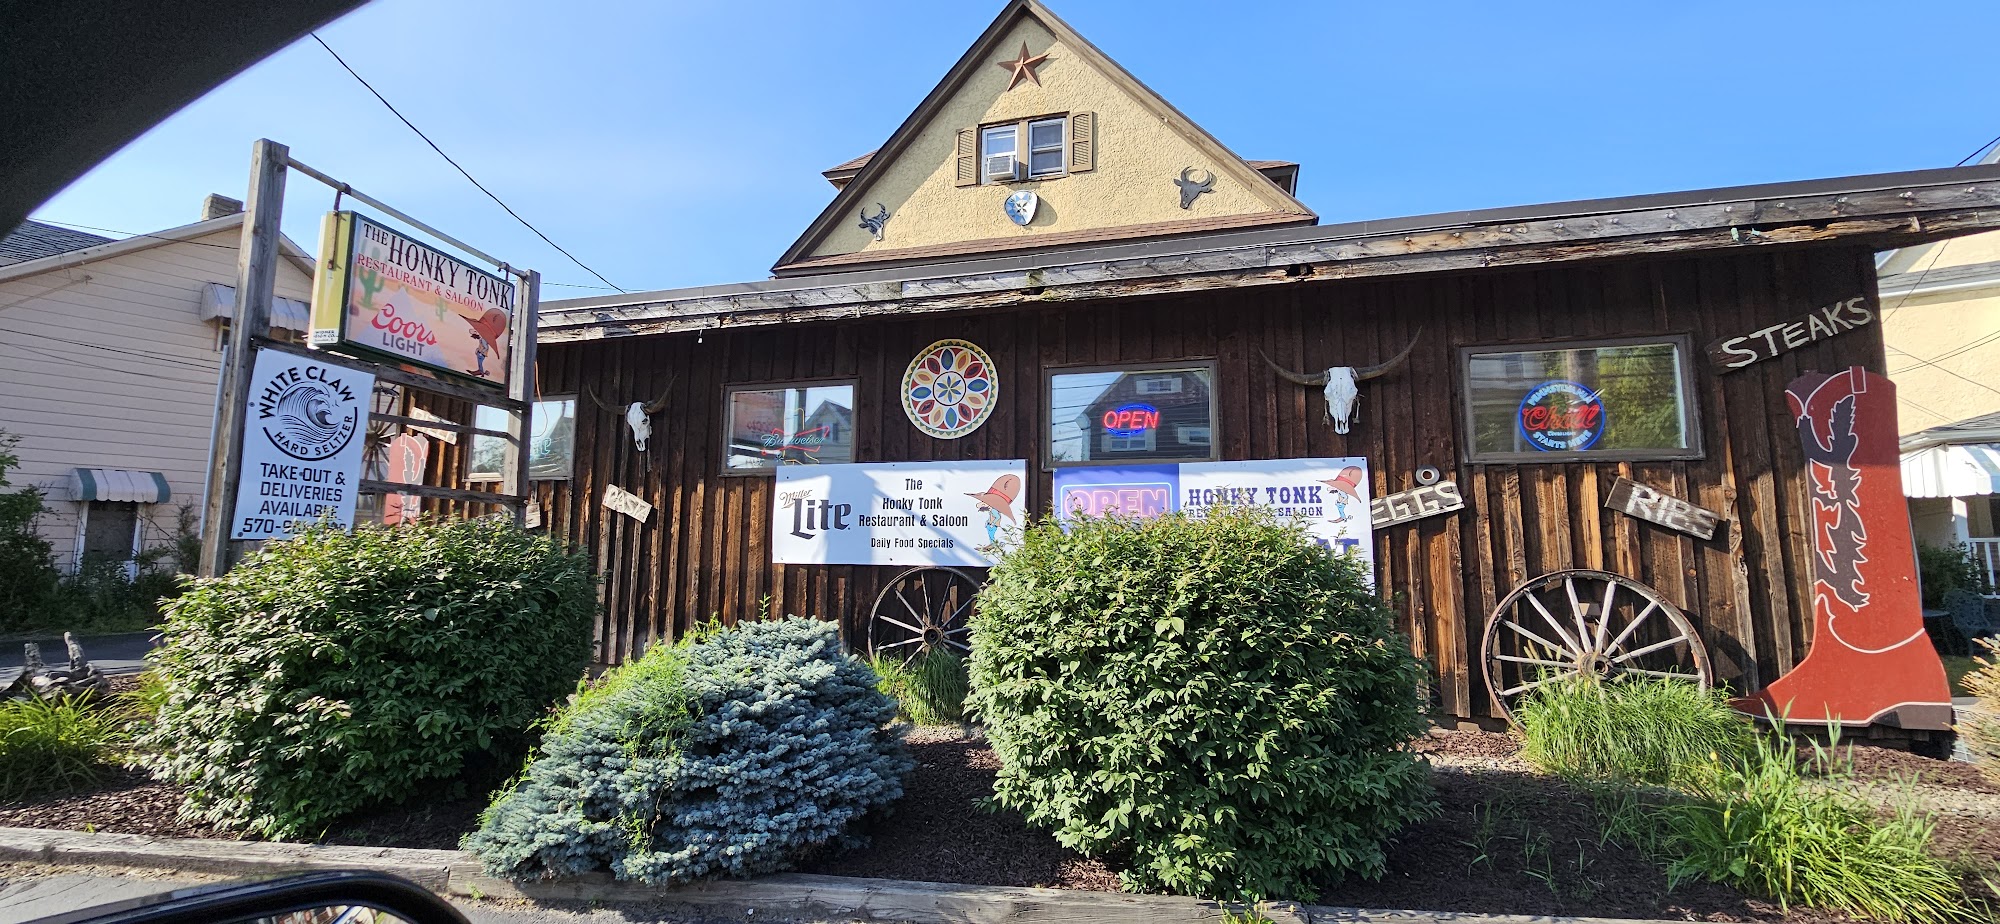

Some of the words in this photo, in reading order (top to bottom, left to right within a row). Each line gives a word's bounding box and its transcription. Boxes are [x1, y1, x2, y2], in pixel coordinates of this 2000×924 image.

[363, 223, 389, 246] THE
[388, 234, 460, 288] HONKY
[465, 269, 510, 311] TONK
[357, 252, 432, 292] RESTAURANT
[434, 285, 442, 297] &
[444, 289, 484, 311] SALOON
[371, 303, 437, 345] Coors
[1721, 296, 1872, 368] STEAKS
[382, 332, 425, 356] LIGHT
[259, 367, 301, 419] WHITE
[305, 366, 355, 402] CLAW
[1103, 409, 1160, 430] OPEN
[1522, 404, 1600, 430] Chill
[274, 431, 309, 455] HARD
[314, 415, 353, 456] SELTZER
[761, 433, 825, 448] Buweiser
[1532, 431, 1567, 449] STARTS
[260, 462, 299, 481] TAKE
[302, 467, 332, 484] OUT
[335, 471, 346, 486] &
[905, 478, 923, 491] The
[259, 481, 343, 502] DELIVERIES
[779, 489, 813, 510] Miller
[1266, 485, 1323, 504] TONK
[882, 497, 914, 511] Honky
[918, 497, 943, 510] Tonk
[1064, 489, 1167, 519] OPEN
[789, 498, 852, 541] Lite
[859, 514, 915, 527] Restaurant
[919, 514, 927, 527] &
[932, 514, 968, 527] Saloon
[870, 537, 891, 549] Daily
[894, 537, 914, 549] Food
[917, 537, 954, 549] Specials
